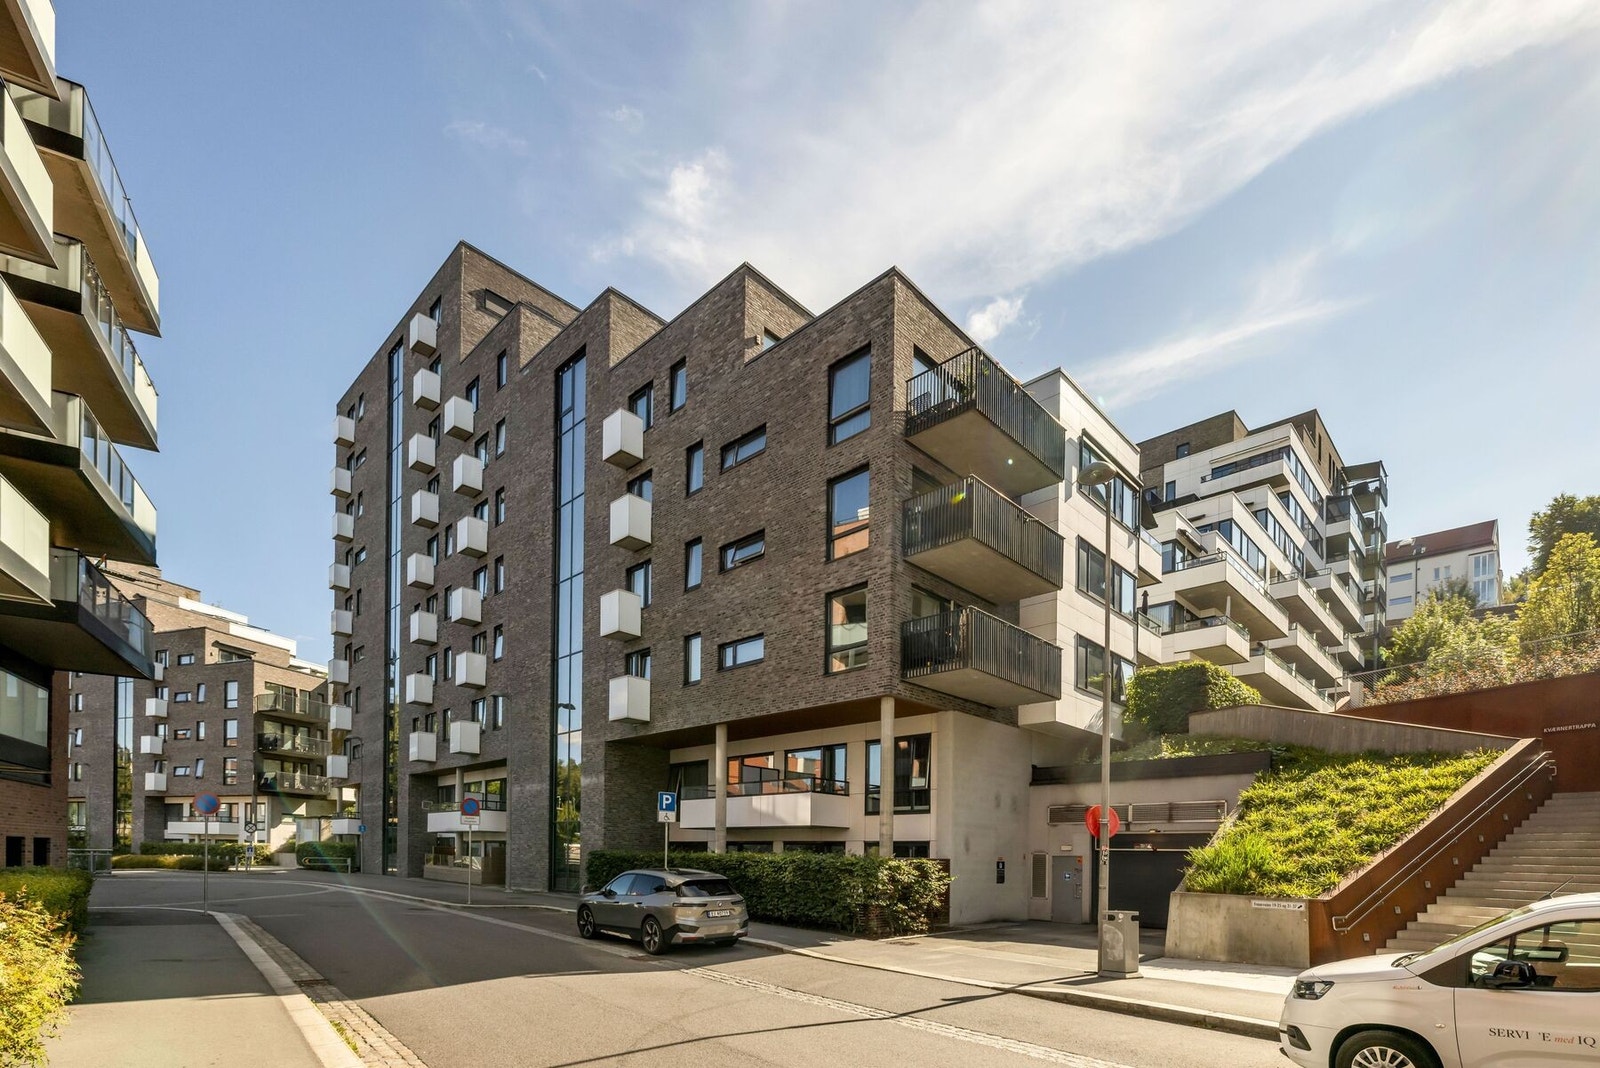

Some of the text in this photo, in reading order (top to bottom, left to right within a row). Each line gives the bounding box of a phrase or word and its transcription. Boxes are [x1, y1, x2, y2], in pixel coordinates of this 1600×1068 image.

[1543, 722, 1597, 733] KVÆRNERTRAPPA
[662, 794, 672, 809] P
[1488, 1027, 1597, 1048] SERVIE med IQ
